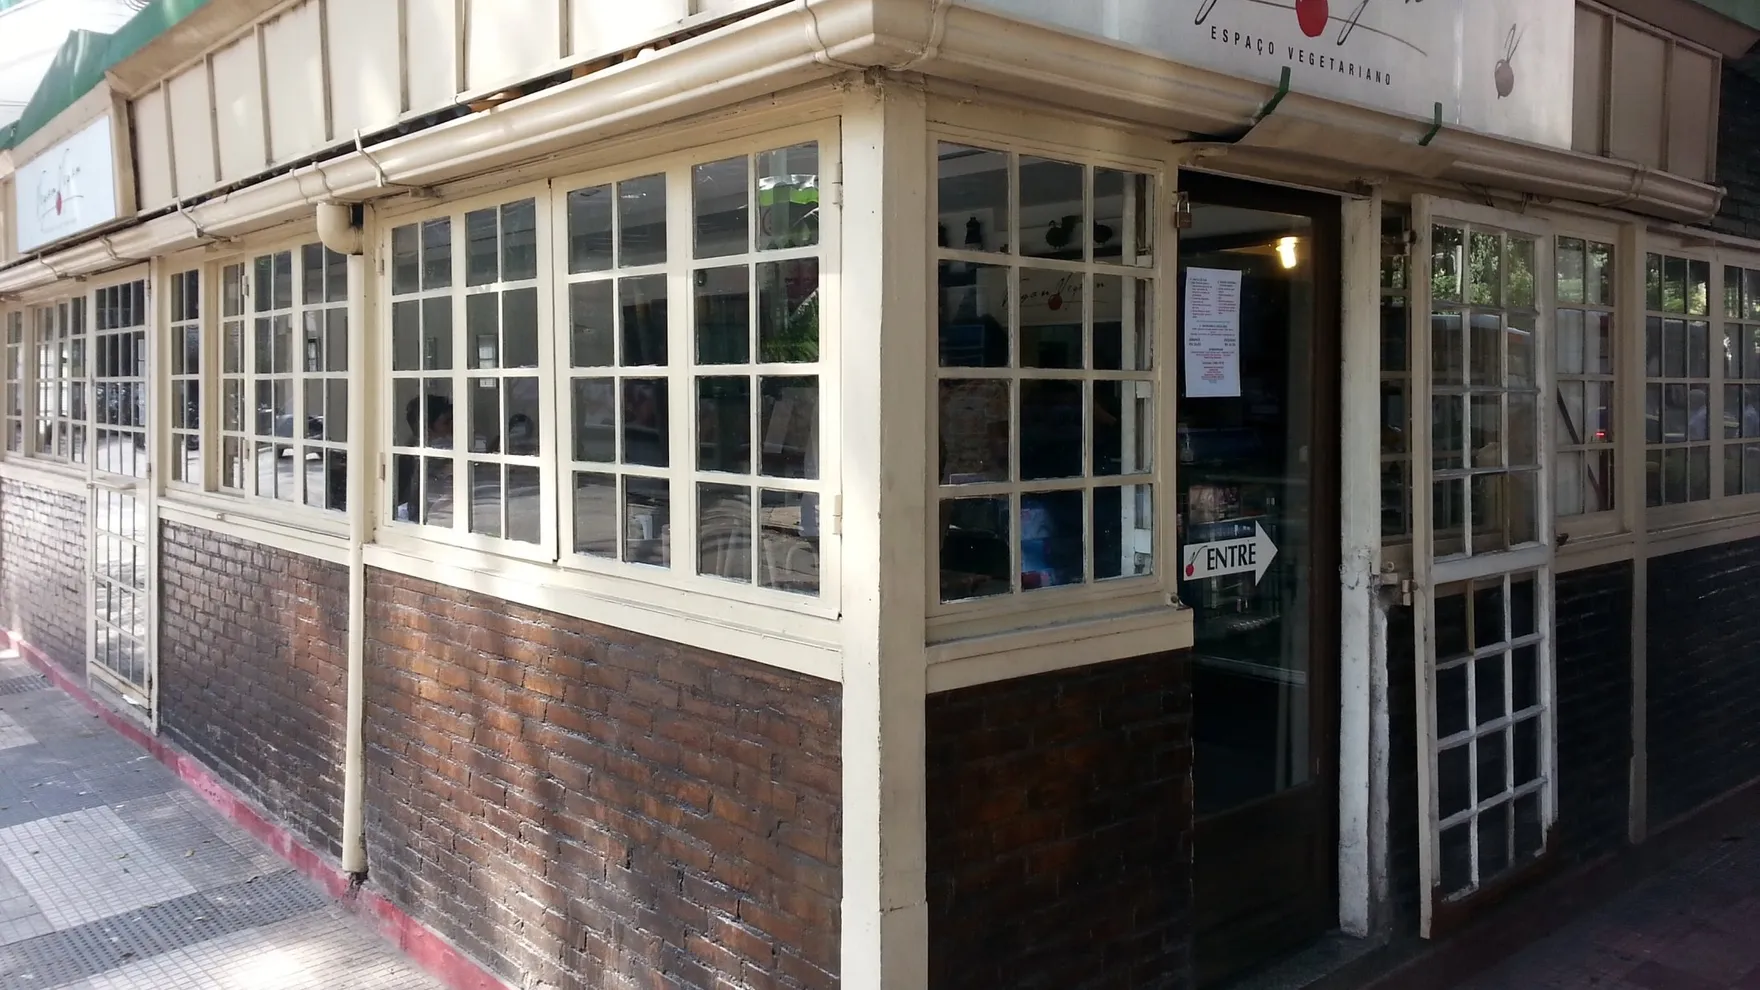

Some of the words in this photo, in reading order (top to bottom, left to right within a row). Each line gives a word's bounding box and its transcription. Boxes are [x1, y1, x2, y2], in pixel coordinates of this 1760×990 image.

[1211, 26, 1275, 55] ESPAÇO
[1287, 46, 1392, 85] VEGETARIANO
[1207, 543, 1256, 571] ENTRE
